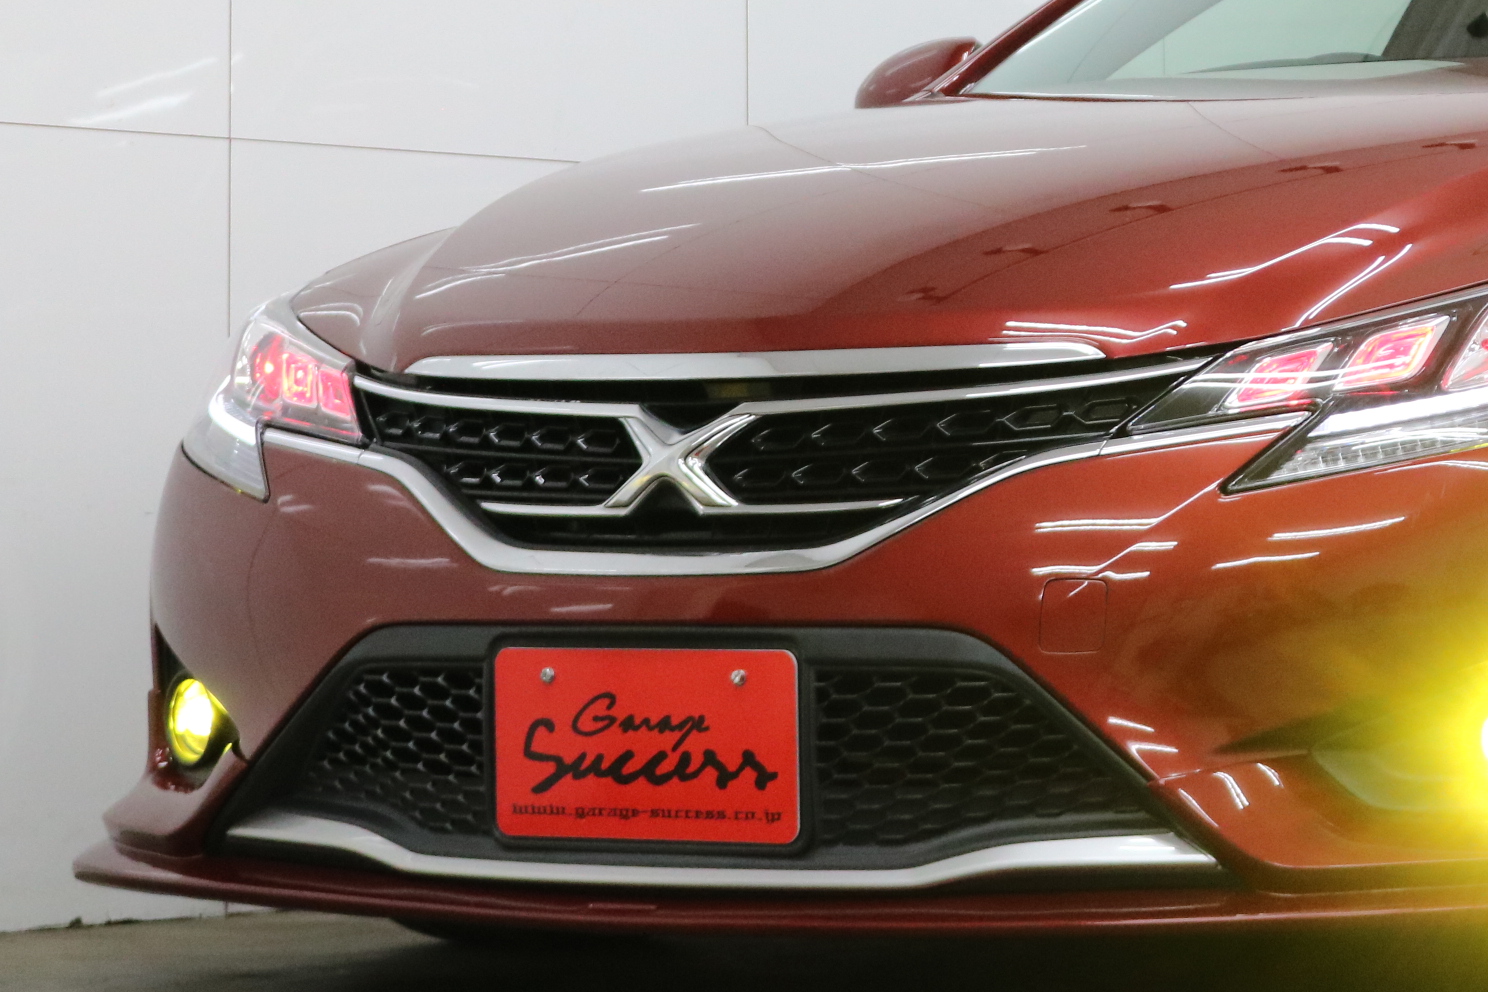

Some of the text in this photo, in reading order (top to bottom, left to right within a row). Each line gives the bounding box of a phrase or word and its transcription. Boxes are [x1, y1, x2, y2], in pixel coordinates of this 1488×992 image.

[572, 692, 710, 752] Garage
[524, 718, 778, 794] Success
[512, 802, 782, 824] www.garage-success.co.jp
